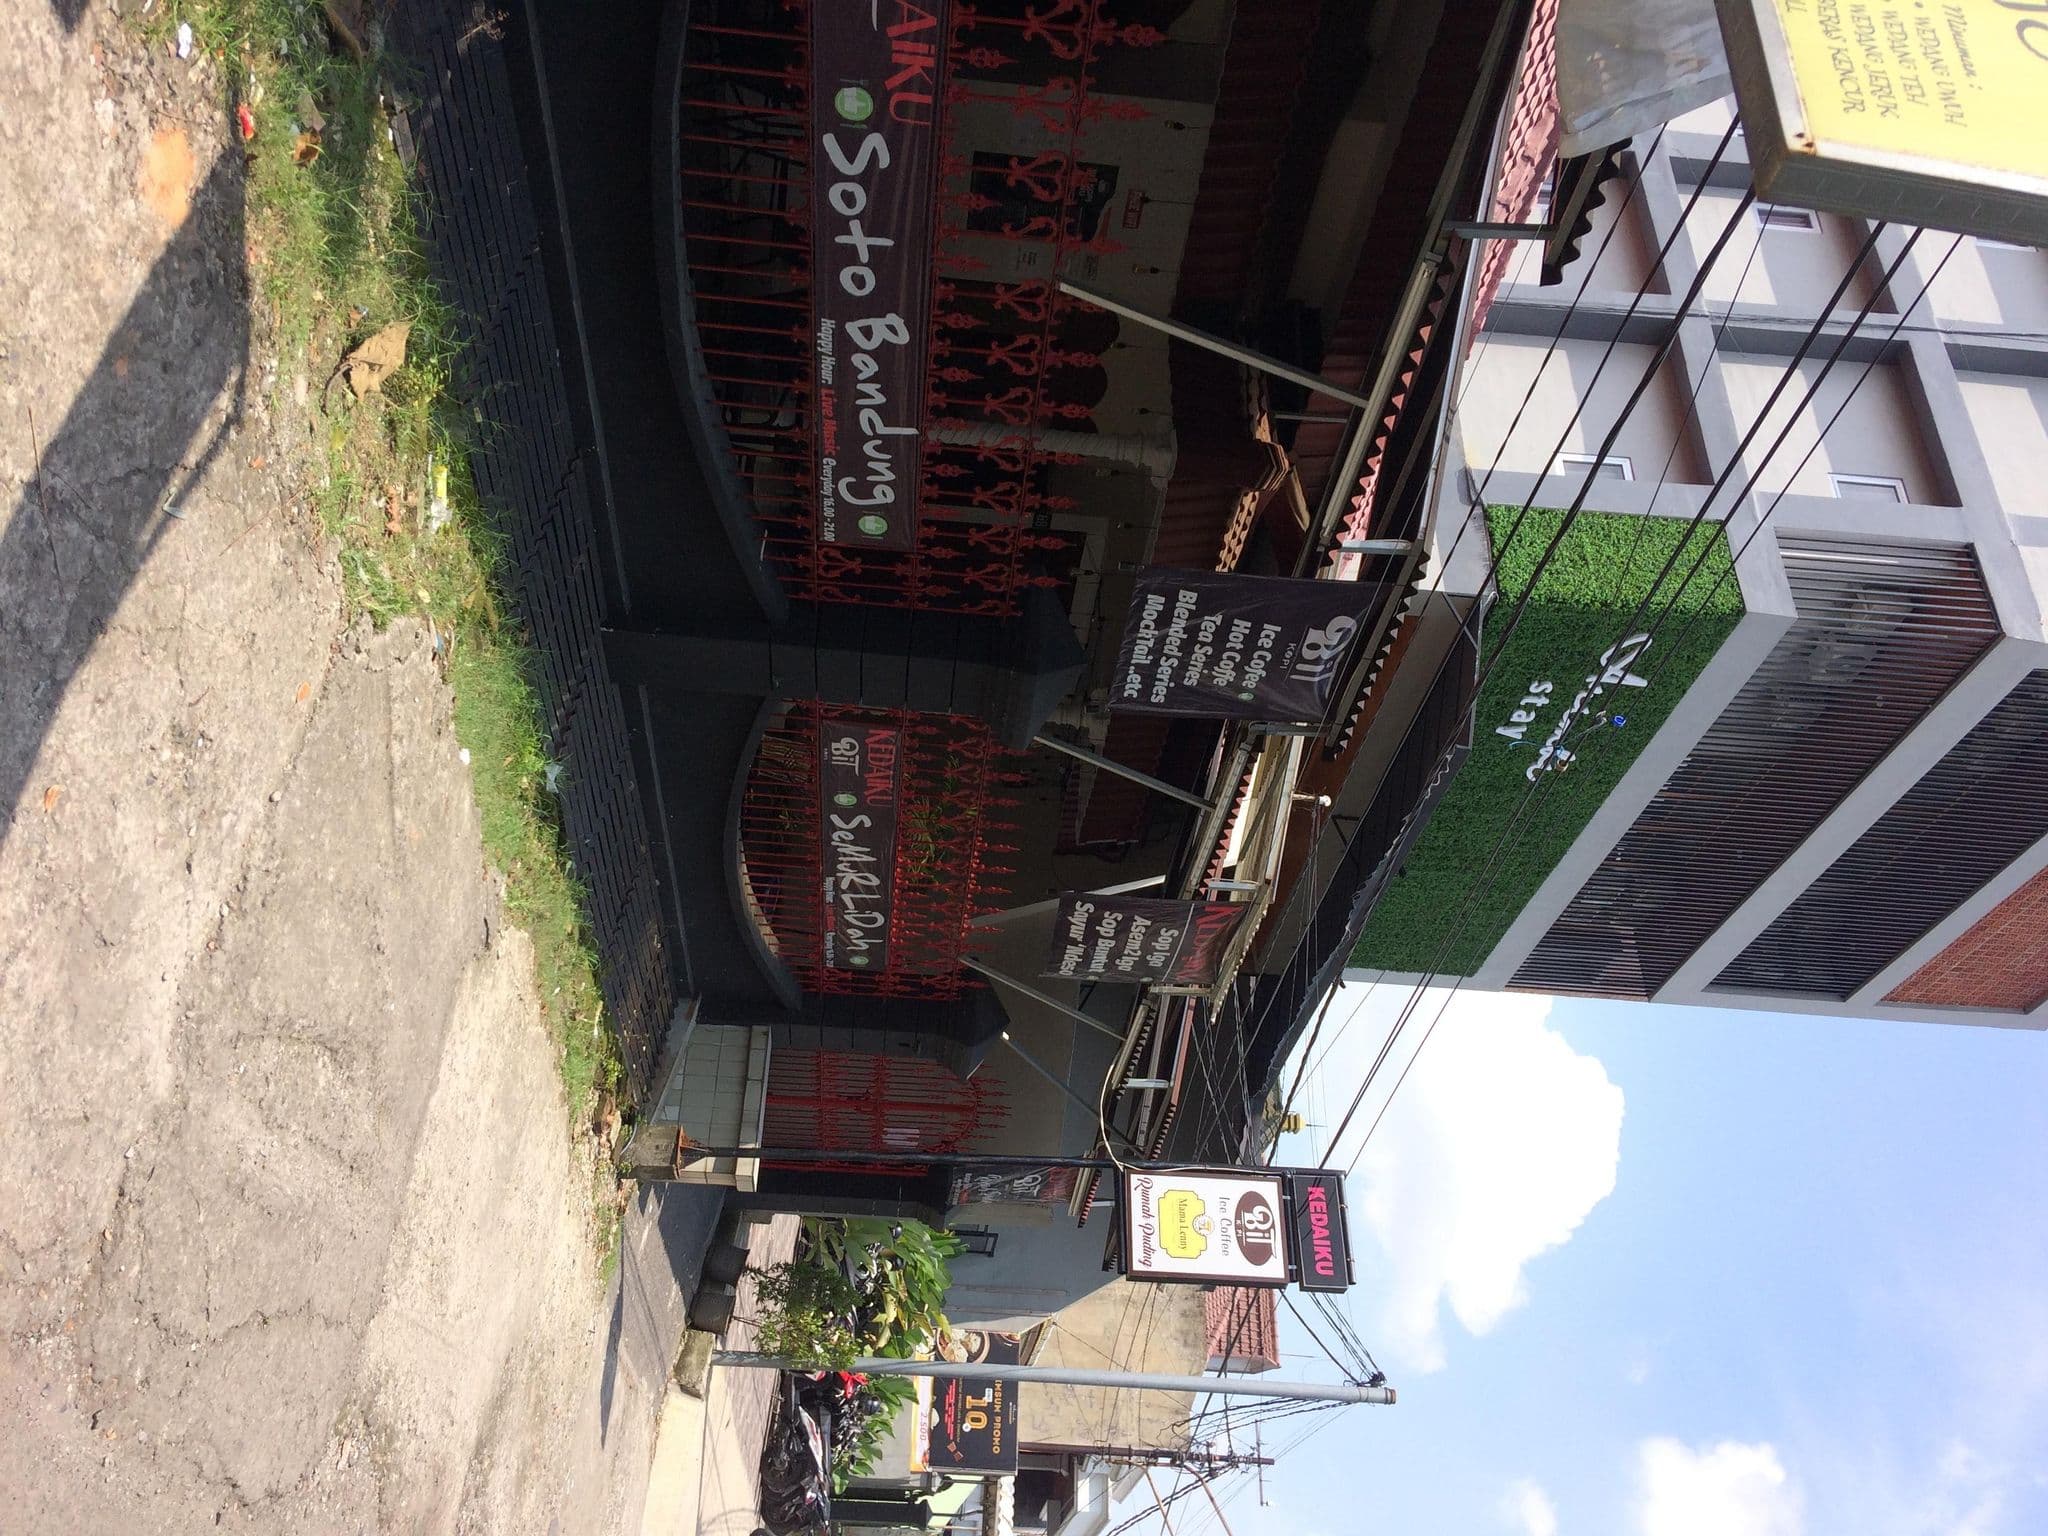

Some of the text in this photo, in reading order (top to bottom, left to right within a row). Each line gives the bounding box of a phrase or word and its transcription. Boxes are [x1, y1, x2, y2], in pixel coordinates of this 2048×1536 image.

[1849, 3, 1901, 119] WEDANG JERUK
[1881, 10, 1929, 107] WEDANG TEH
[1914, 17, 1950, 77] WEDANG
[1941, 4, 1977, 78] Minuman
[1826, 46, 1866, 114] KENCUR
[817, 318, 836, 355] Happy
[822, 132, 919, 505] Soto Bandung
[1150, 589, 1198, 703] Blended Series
[1182, 614, 1223, 686] Tea Series
[1211, 618, 1252, 687] Hot Coffe
[1242, 623, 1282, 689] Ice Cofee
[1495, 680, 1553, 740] stay
[1088, 911, 1123, 973] Sop Buntut
[1123, 915, 1152, 956] Asem2
[1151, 927, 1180, 950] Sop
[1134, 1177, 1157, 1267] Rumah Puding
[1177, 1198, 1189, 1250] Mama Lenny
[1218, 1196, 1232, 1257] Ice Coffee
[1307, 1187, 1334, 1276] KEDAIKU
[965, 1395, 988, 1430] 10
[992, 1416, 1001, 1454] PROMO
